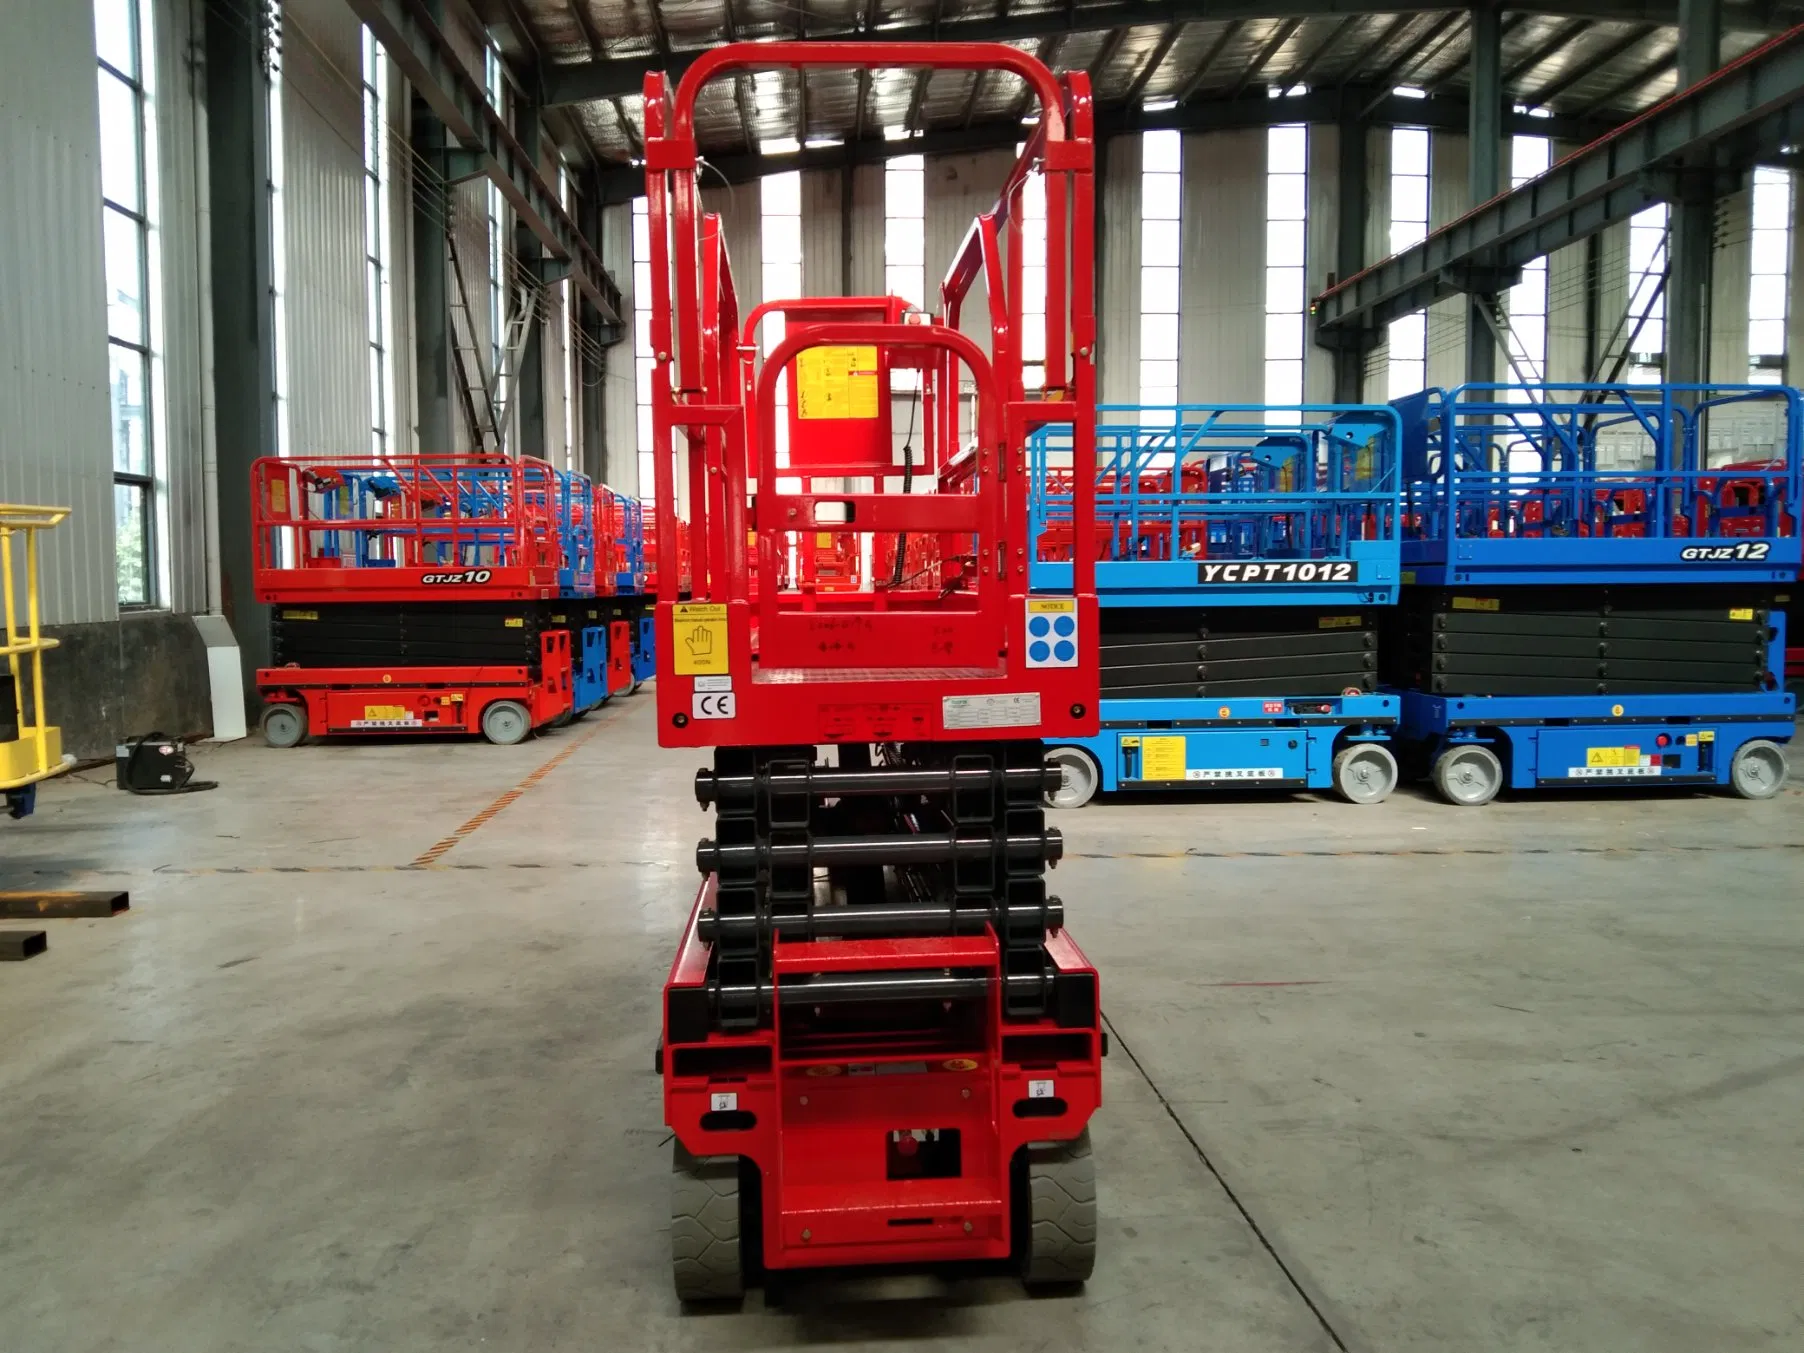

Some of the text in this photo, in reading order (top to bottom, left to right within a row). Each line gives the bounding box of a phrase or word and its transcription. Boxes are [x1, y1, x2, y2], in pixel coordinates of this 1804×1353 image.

[1681, 542, 1770, 560] GTJZ12
[421, 570, 491, 584] GTJZ10
[1203, 562, 1352, 582] YCPT1012
[1040, 602, 1065, 610] NOTICE
[700, 695, 729, 715] CE
